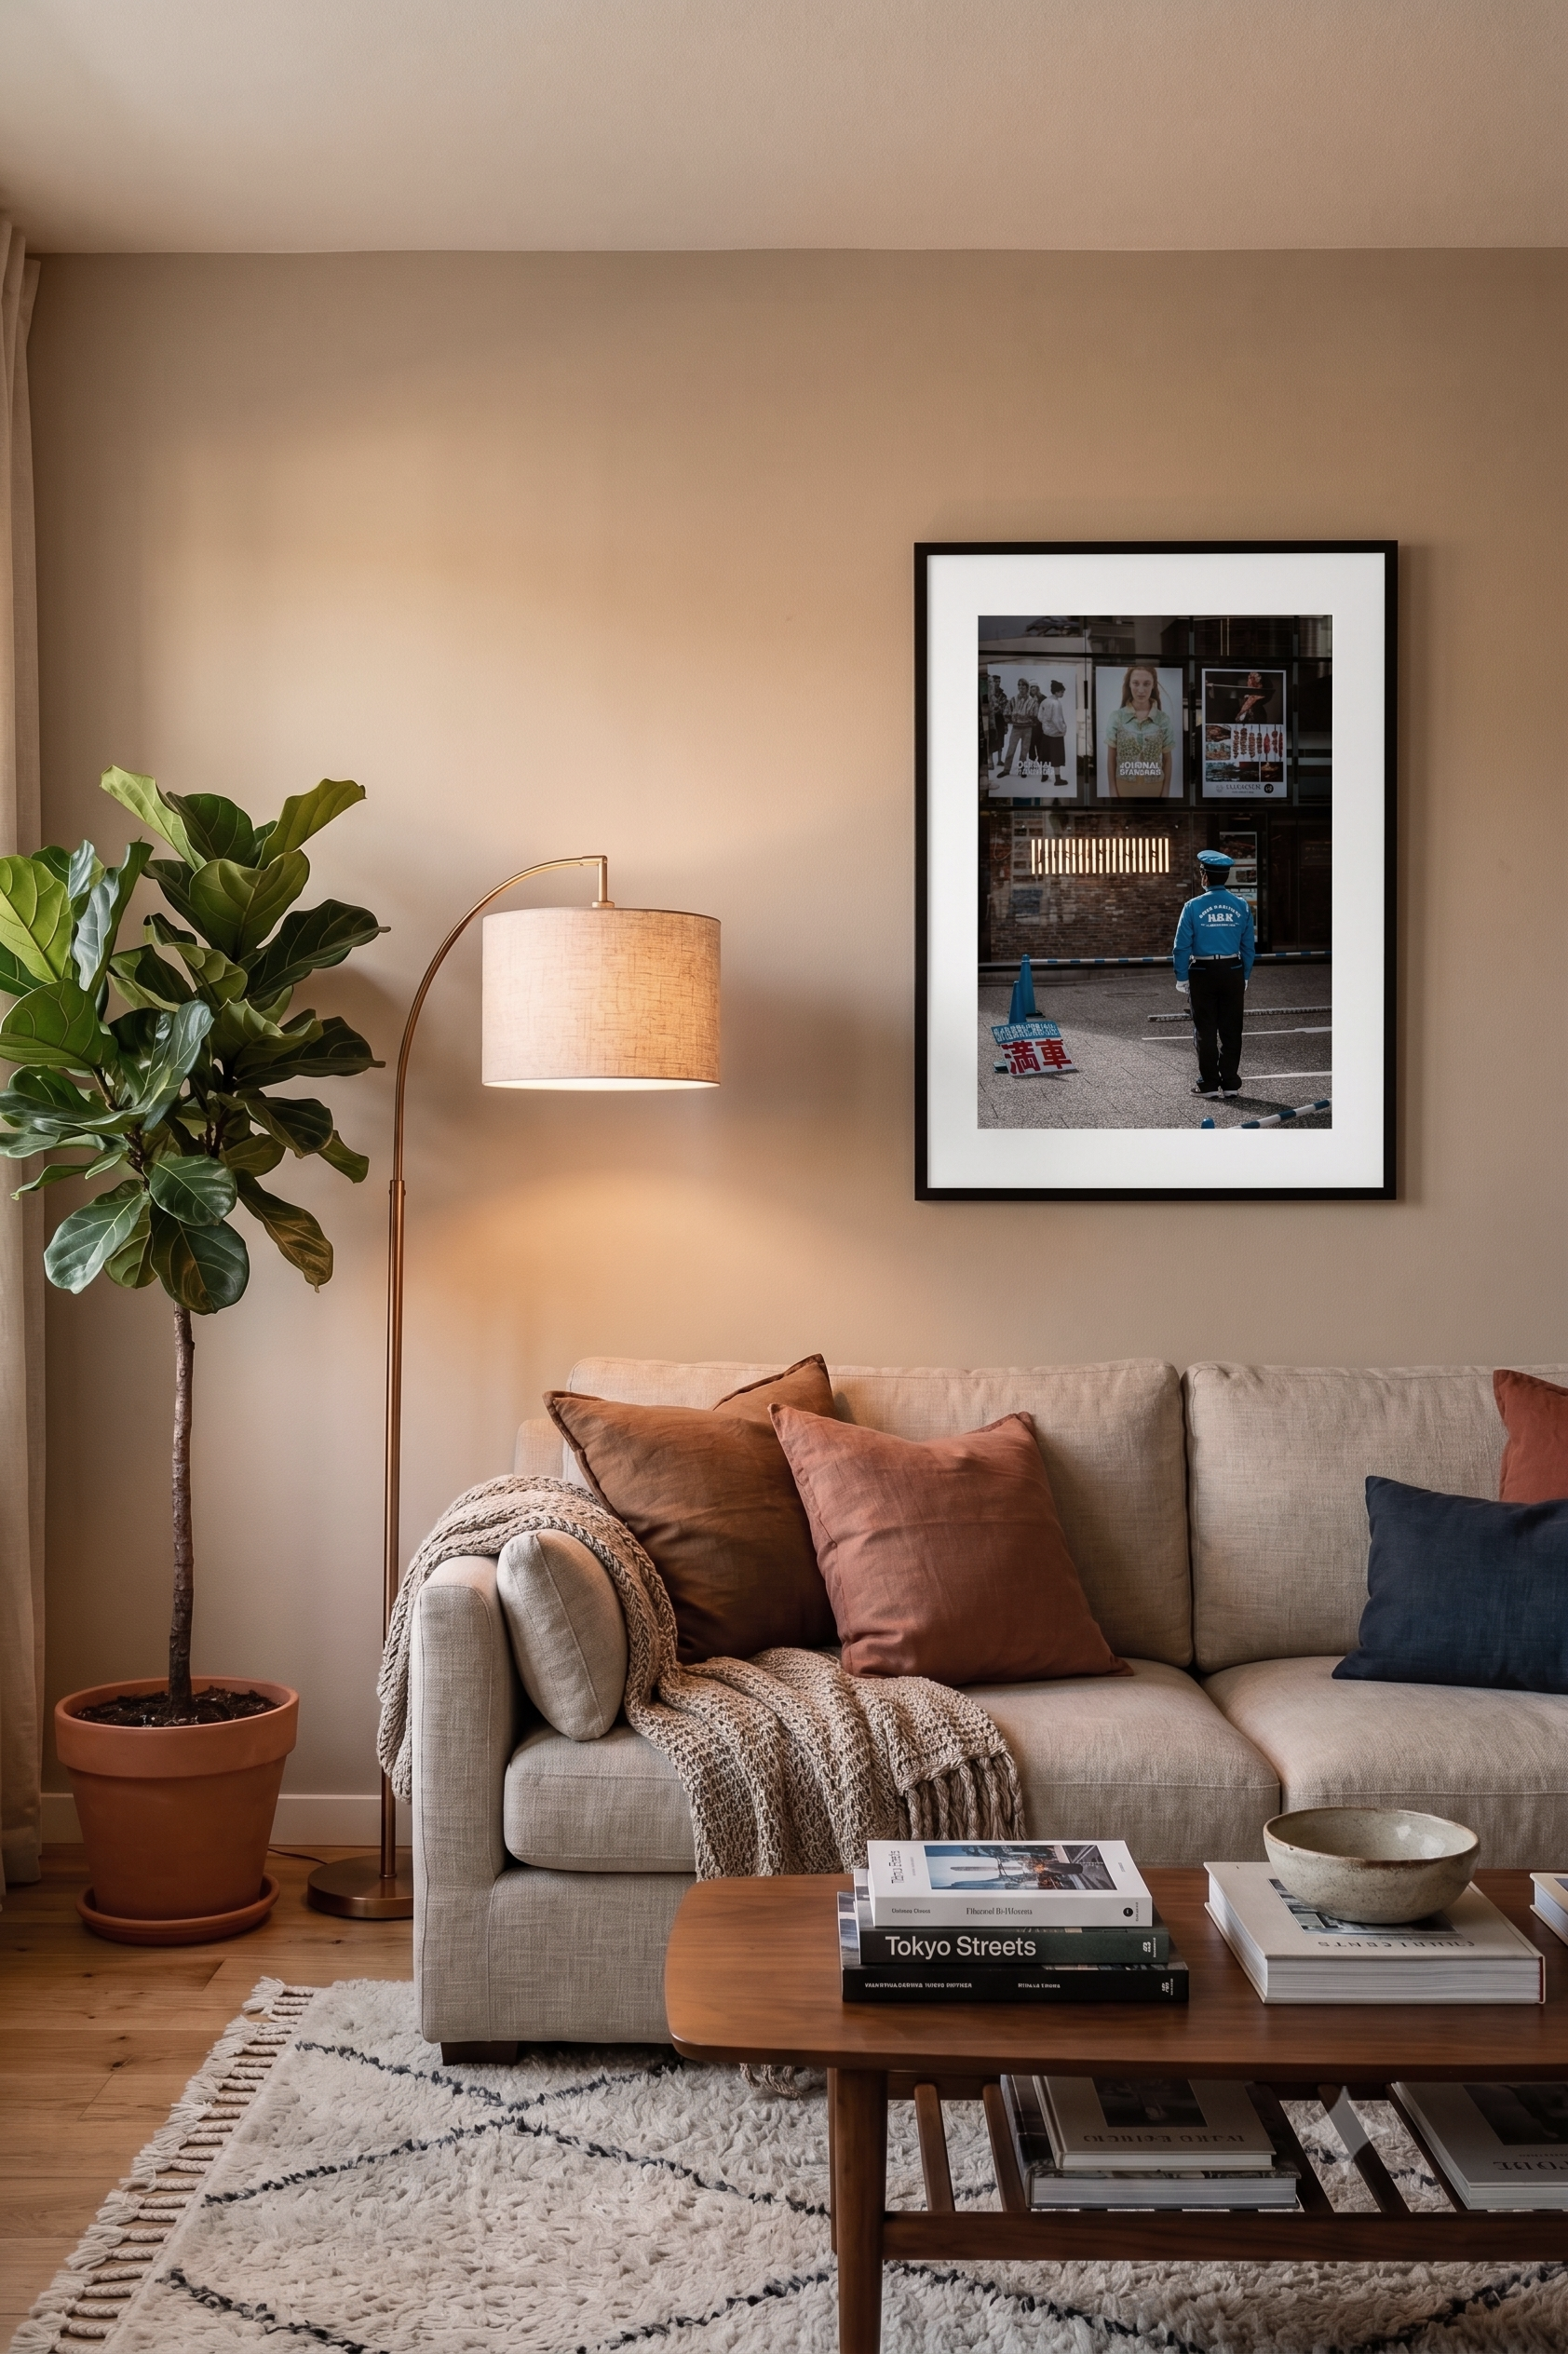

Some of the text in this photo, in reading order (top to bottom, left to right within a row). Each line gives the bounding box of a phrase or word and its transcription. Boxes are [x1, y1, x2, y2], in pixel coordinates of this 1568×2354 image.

[1001, 1038, 1073, 1075] 満車
[885, 1936, 1036, 1959] Tokyo Streets
